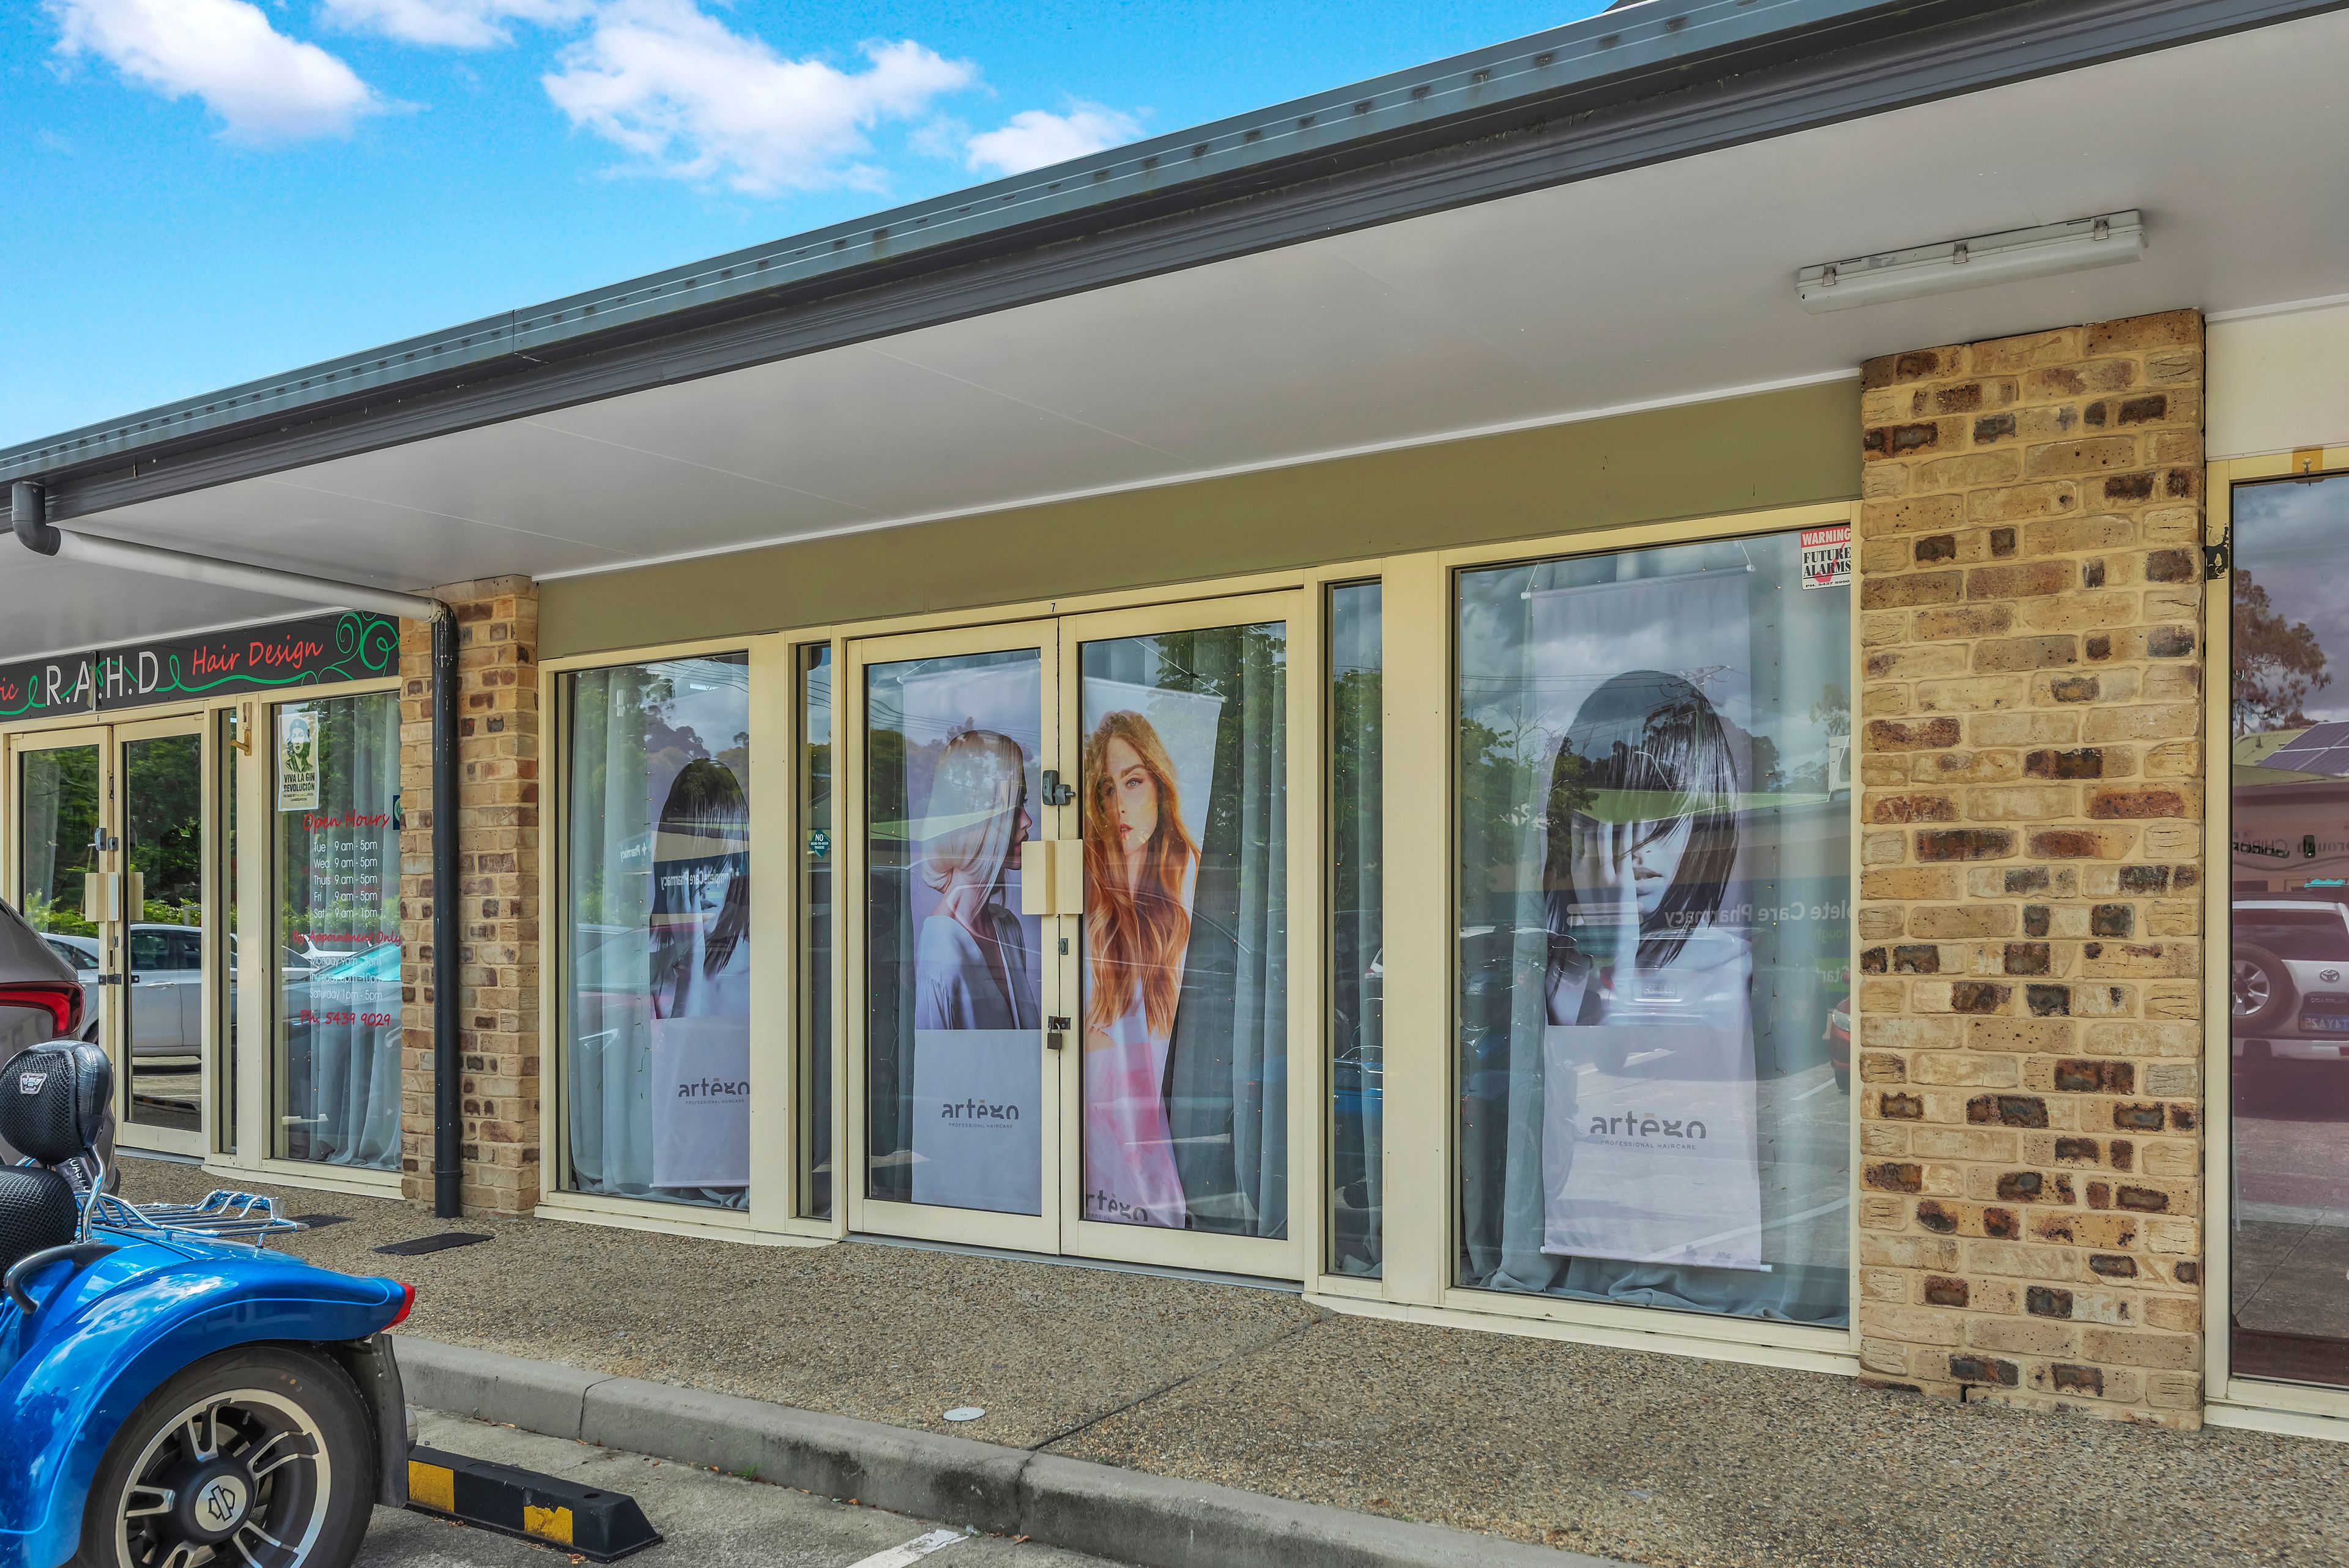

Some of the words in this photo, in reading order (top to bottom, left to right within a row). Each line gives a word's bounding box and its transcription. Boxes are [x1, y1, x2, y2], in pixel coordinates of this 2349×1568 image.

[1802, 528, 1850, 545] WARNING
[1804, 547, 1850, 563] FUTURE
[1804, 560, 1850, 577] ALARMS
[1052, 603, 1056, 612] 7
[0, 677, 19, 701] ic
[193, 644, 240, 675] Hair
[249, 634, 324, 669] Design
[284, 774, 296, 783] VIVA
[298, 773, 304, 782] LA
[305, 772, 315, 781] GIN
[303, 813, 342, 834] Open
[344, 809, 390, 828] Hours
[314, 842, 325, 852] Tue
[335, 841, 340, 851] 9
[360, 840, 377, 852] 5pm
[314, 859, 330, 868] Wed
[335, 858, 340, 868] 9
[360, 857, 377, 869] 5pm
[314, 875, 330, 885] Thurs
[335, 875, 340, 885] 9
[360, 874, 377, 886] 5pm
[335, 891, 340, 901] 9
[360, 891, 377, 903] 5pm
[314, 908, 325, 918] Sat
[335, 908, 340, 918] 9
[362, 908, 377, 920] 1pm
[292, 930, 304, 945] By
[308, 930, 373, 946] Appointment
[375, 930, 401, 946] Only
[310, 955, 340, 967] Monday
[310, 987, 340, 1001] Saturday
[343, 989, 358, 1000] 1pm
[365, 989, 382, 1002] 5pm
[325, 1011, 355, 1025] 5439
[361, 1013, 390, 1027] 9029
[1600, 1140, 1654, 1148] PROFESSIONAL
